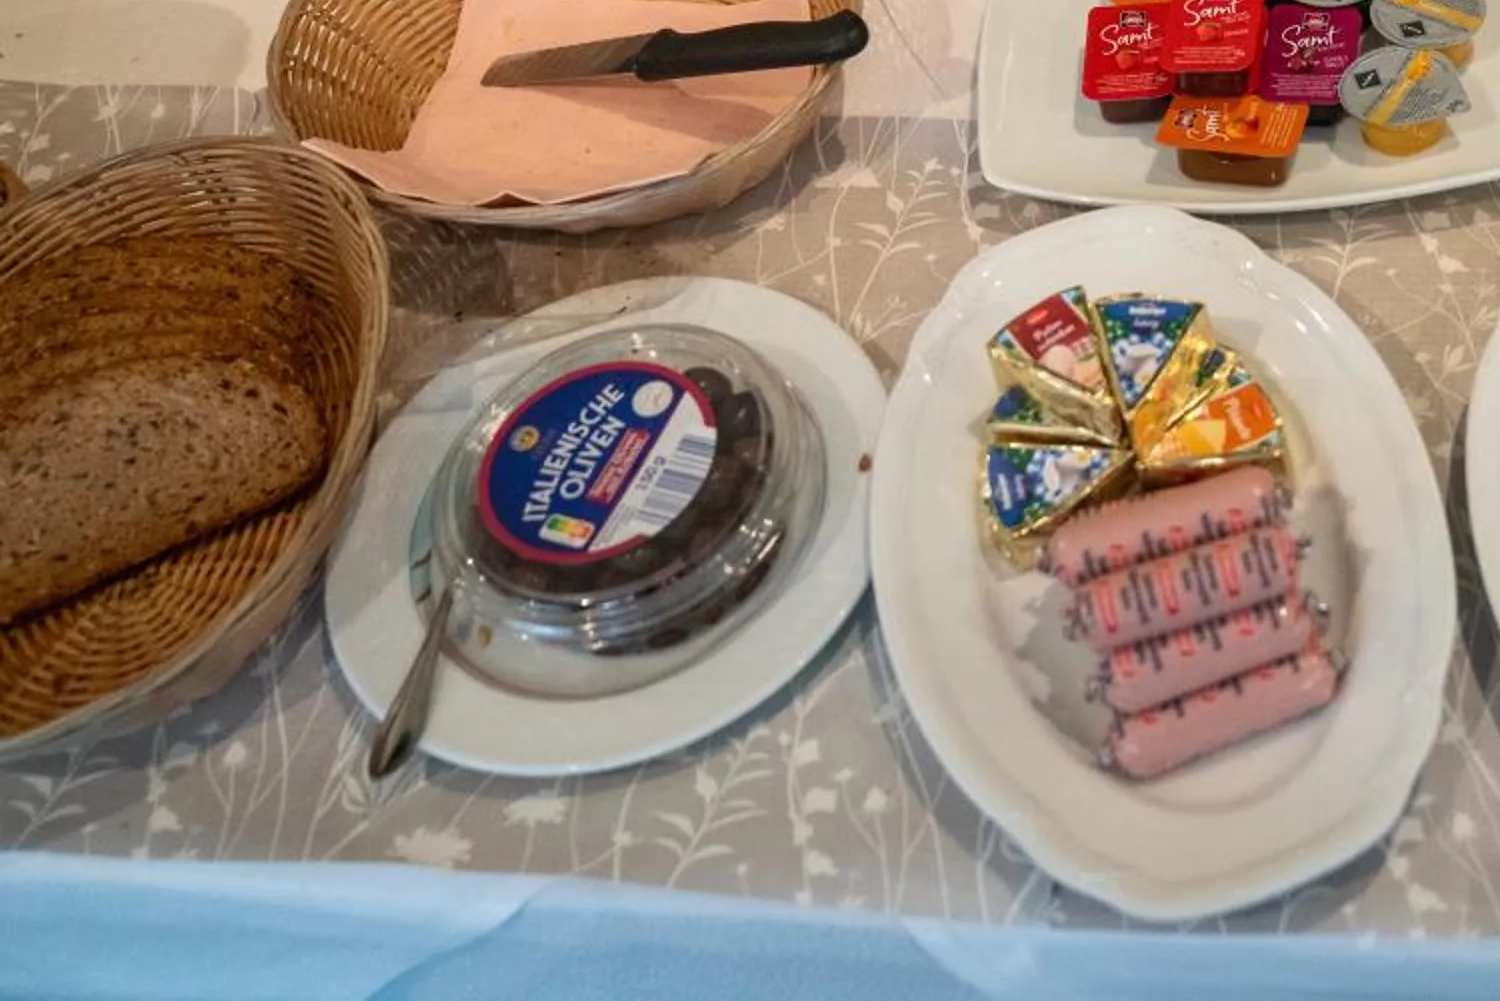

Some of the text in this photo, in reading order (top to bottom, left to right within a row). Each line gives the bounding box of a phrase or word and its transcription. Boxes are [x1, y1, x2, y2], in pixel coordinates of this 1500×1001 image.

[1101, 21, 1158, 55] Samt
[1281, 25, 1343, 58] Samt
[522, 384, 624, 522] ITALIENISCHE
[560, 416, 626, 499] OLIVEN
